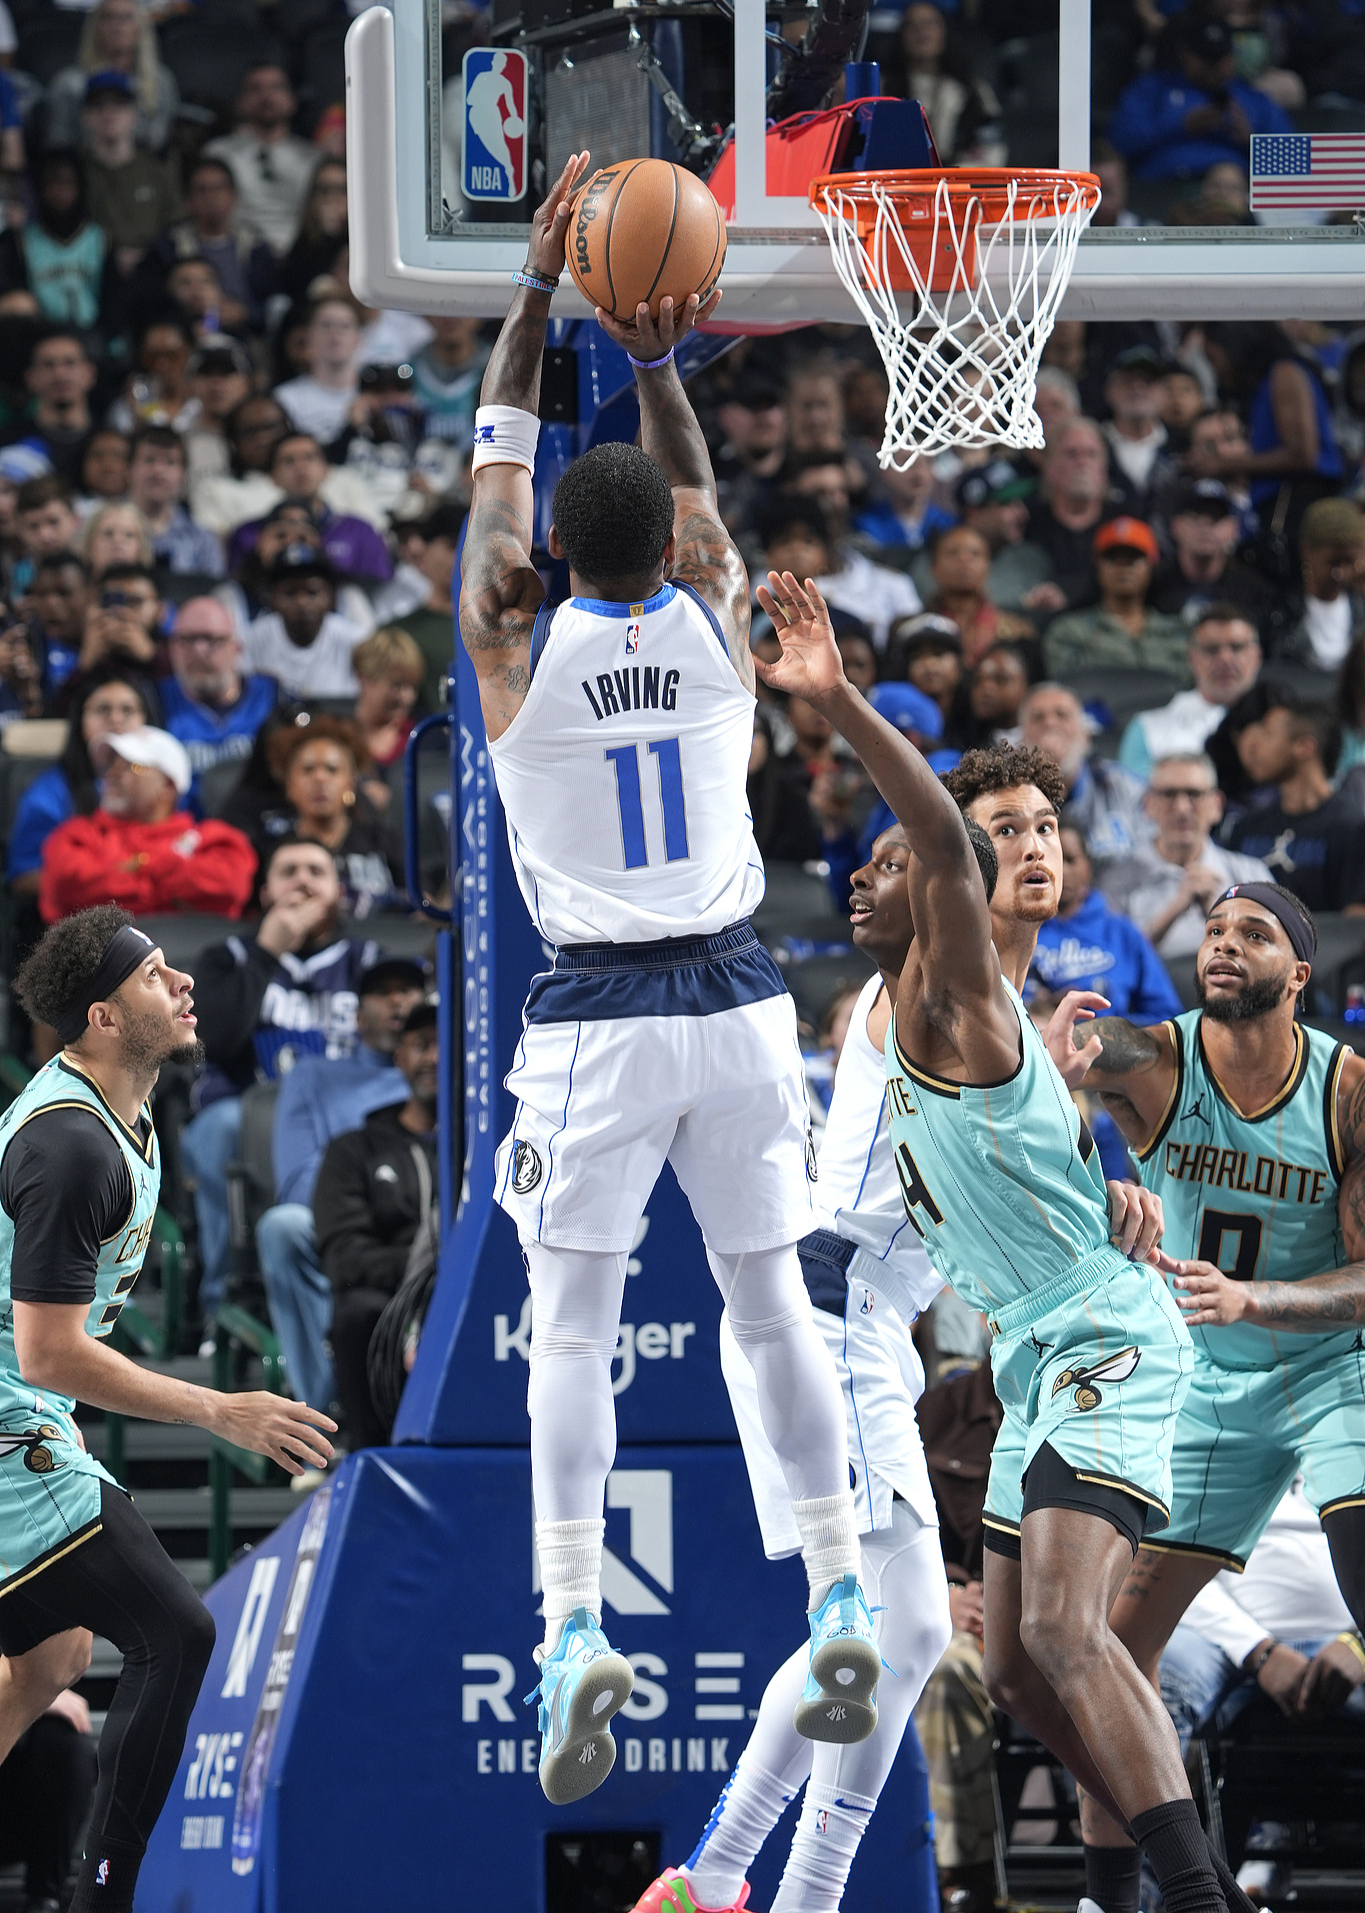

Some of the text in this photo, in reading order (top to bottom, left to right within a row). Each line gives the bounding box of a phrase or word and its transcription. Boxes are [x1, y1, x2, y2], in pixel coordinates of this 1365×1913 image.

[471, 166, 502, 191] NBA
[575, 169, 621, 276] Wilson
[581, 666, 681, 721] IRVING
[603, 735, 690, 871] 11
[478, 965, 489, 1133] CASINOS
[1165, 1140, 1328, 1205] CHARLOTTE
[494, 1293, 696, 1396] Kger
[461, 1652, 745, 1722] RSE
[184, 1731, 244, 1800] RYSE
[477, 1738, 730, 1773] ENE DRINK
